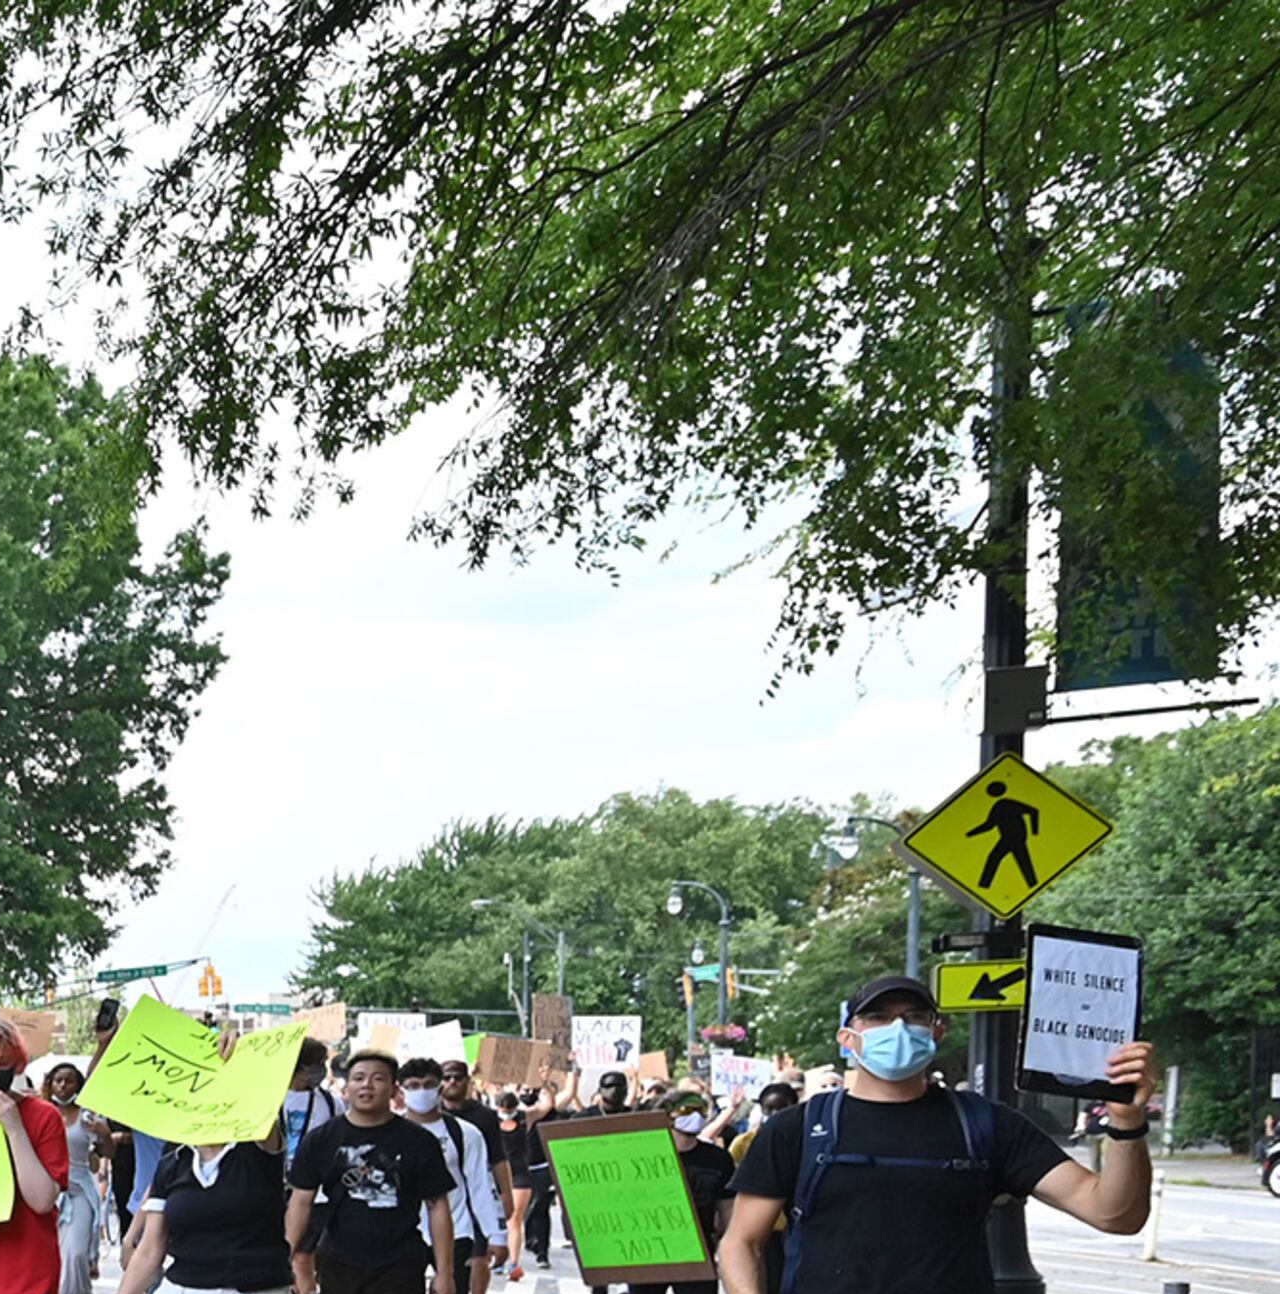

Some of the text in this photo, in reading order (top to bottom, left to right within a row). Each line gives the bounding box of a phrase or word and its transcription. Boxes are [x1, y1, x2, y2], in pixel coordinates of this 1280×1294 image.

[1043, 968, 1125, 993] WHITE SILENCE
[576, 1018, 635, 1032] LACK
[1033, 1017, 1126, 1044] BLACK GENOCIDE
[614, 1237, 670, 1261] LOVE
